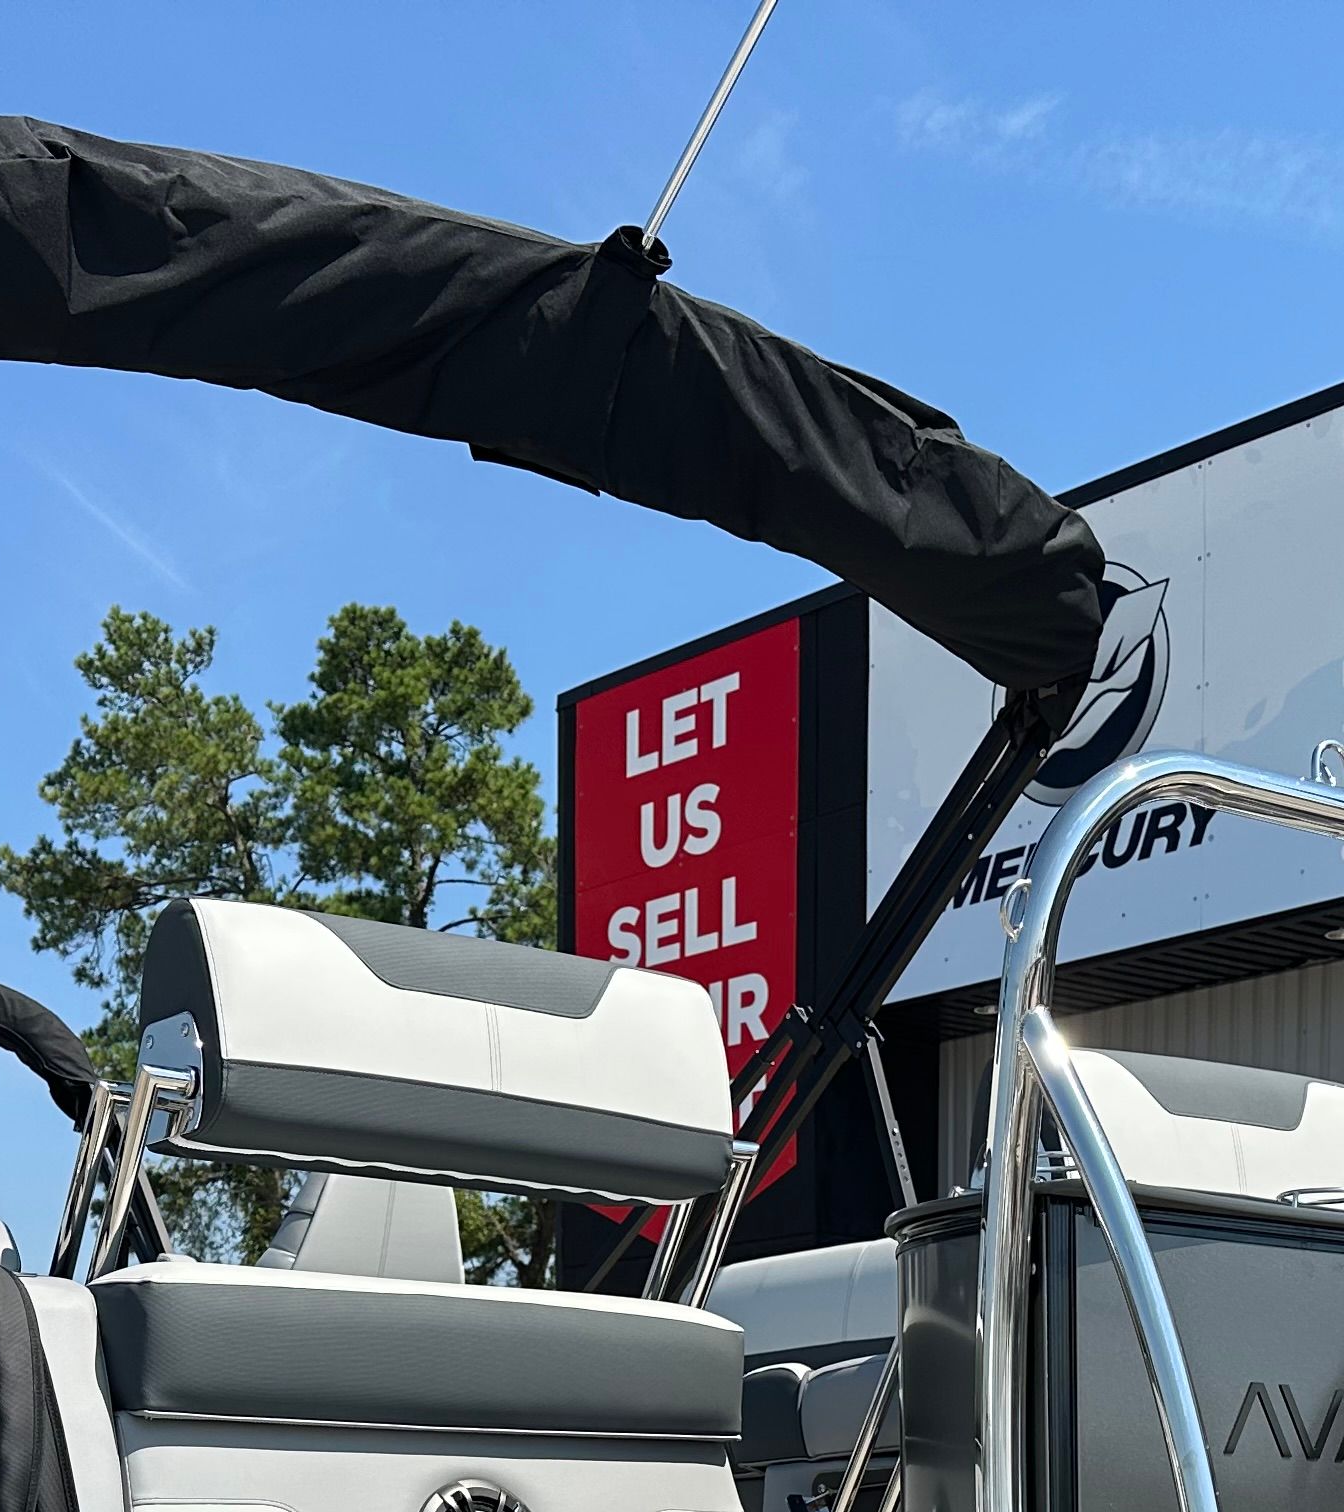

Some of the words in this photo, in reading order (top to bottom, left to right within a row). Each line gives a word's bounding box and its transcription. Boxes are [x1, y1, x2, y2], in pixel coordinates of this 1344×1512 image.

[625, 671, 741, 779] LET
[640, 782, 723, 869] US
[942, 799, 1217, 912] MEURY
[607, 876, 758, 969] SELL
